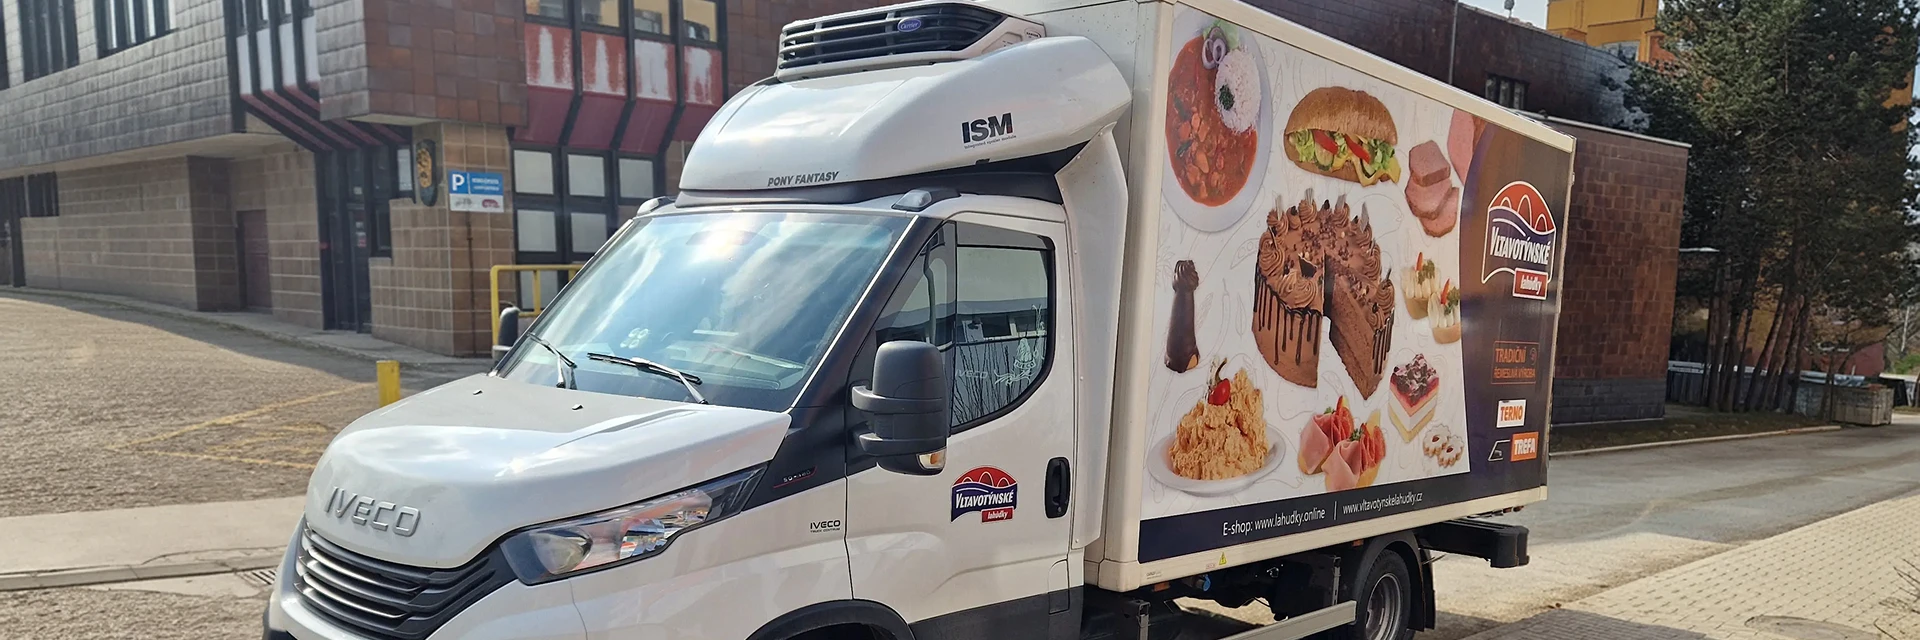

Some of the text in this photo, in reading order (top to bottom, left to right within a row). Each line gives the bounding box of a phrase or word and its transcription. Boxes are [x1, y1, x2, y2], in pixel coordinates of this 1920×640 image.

[900, 21, 919, 30] Carrier
[962, 112, 1013, 144] ISM
[452, 173, 465, 191] P
[767, 171, 840, 187] PONY FANTASY
[1495, 346, 1527, 363] TRADIČNÍ
[1500, 405, 1523, 421] TERNO
[1513, 437, 1536, 455] TREFA
[324, 486, 421, 538] IVECO
[1342, 491, 1423, 515] www.vltavotynskelahudky.cz
[809, 519, 841, 530] IVECO
[1222, 507, 1326, 536] E-shop: www.lahudky.online
